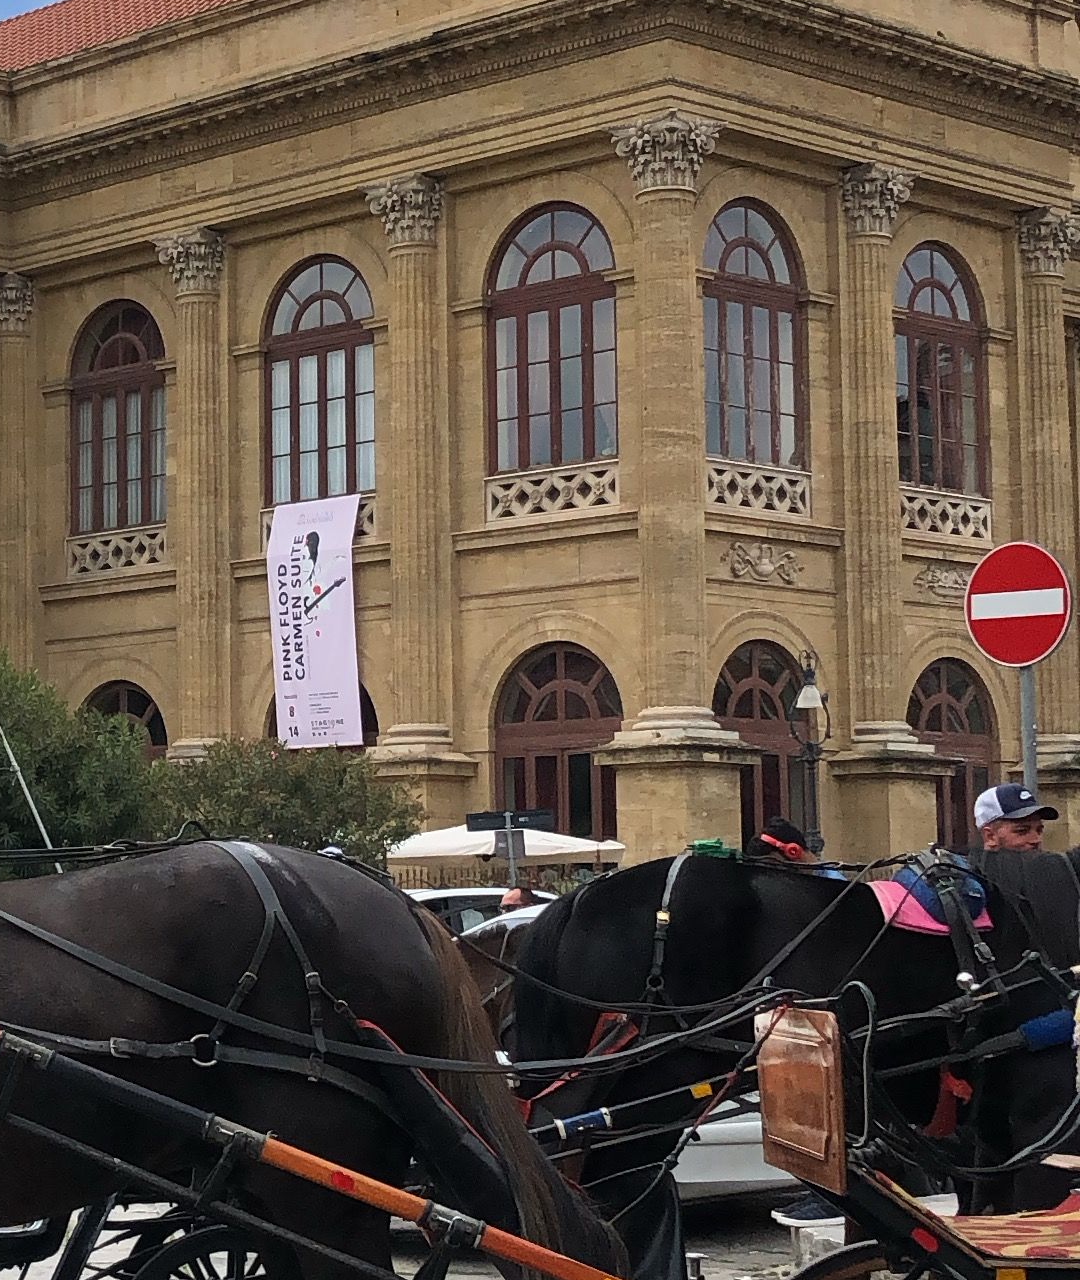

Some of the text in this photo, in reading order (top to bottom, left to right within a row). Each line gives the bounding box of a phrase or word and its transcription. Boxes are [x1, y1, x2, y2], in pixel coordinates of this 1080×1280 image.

[290, 535, 304, 588] SUITE
[278, 564, 290, 626] FLOYD
[281, 634, 293, 681] PINK
[291, 596, 306, 681] CARMEN
[288, 705, 295, 718] 8
[288, 726, 300, 738] 14
